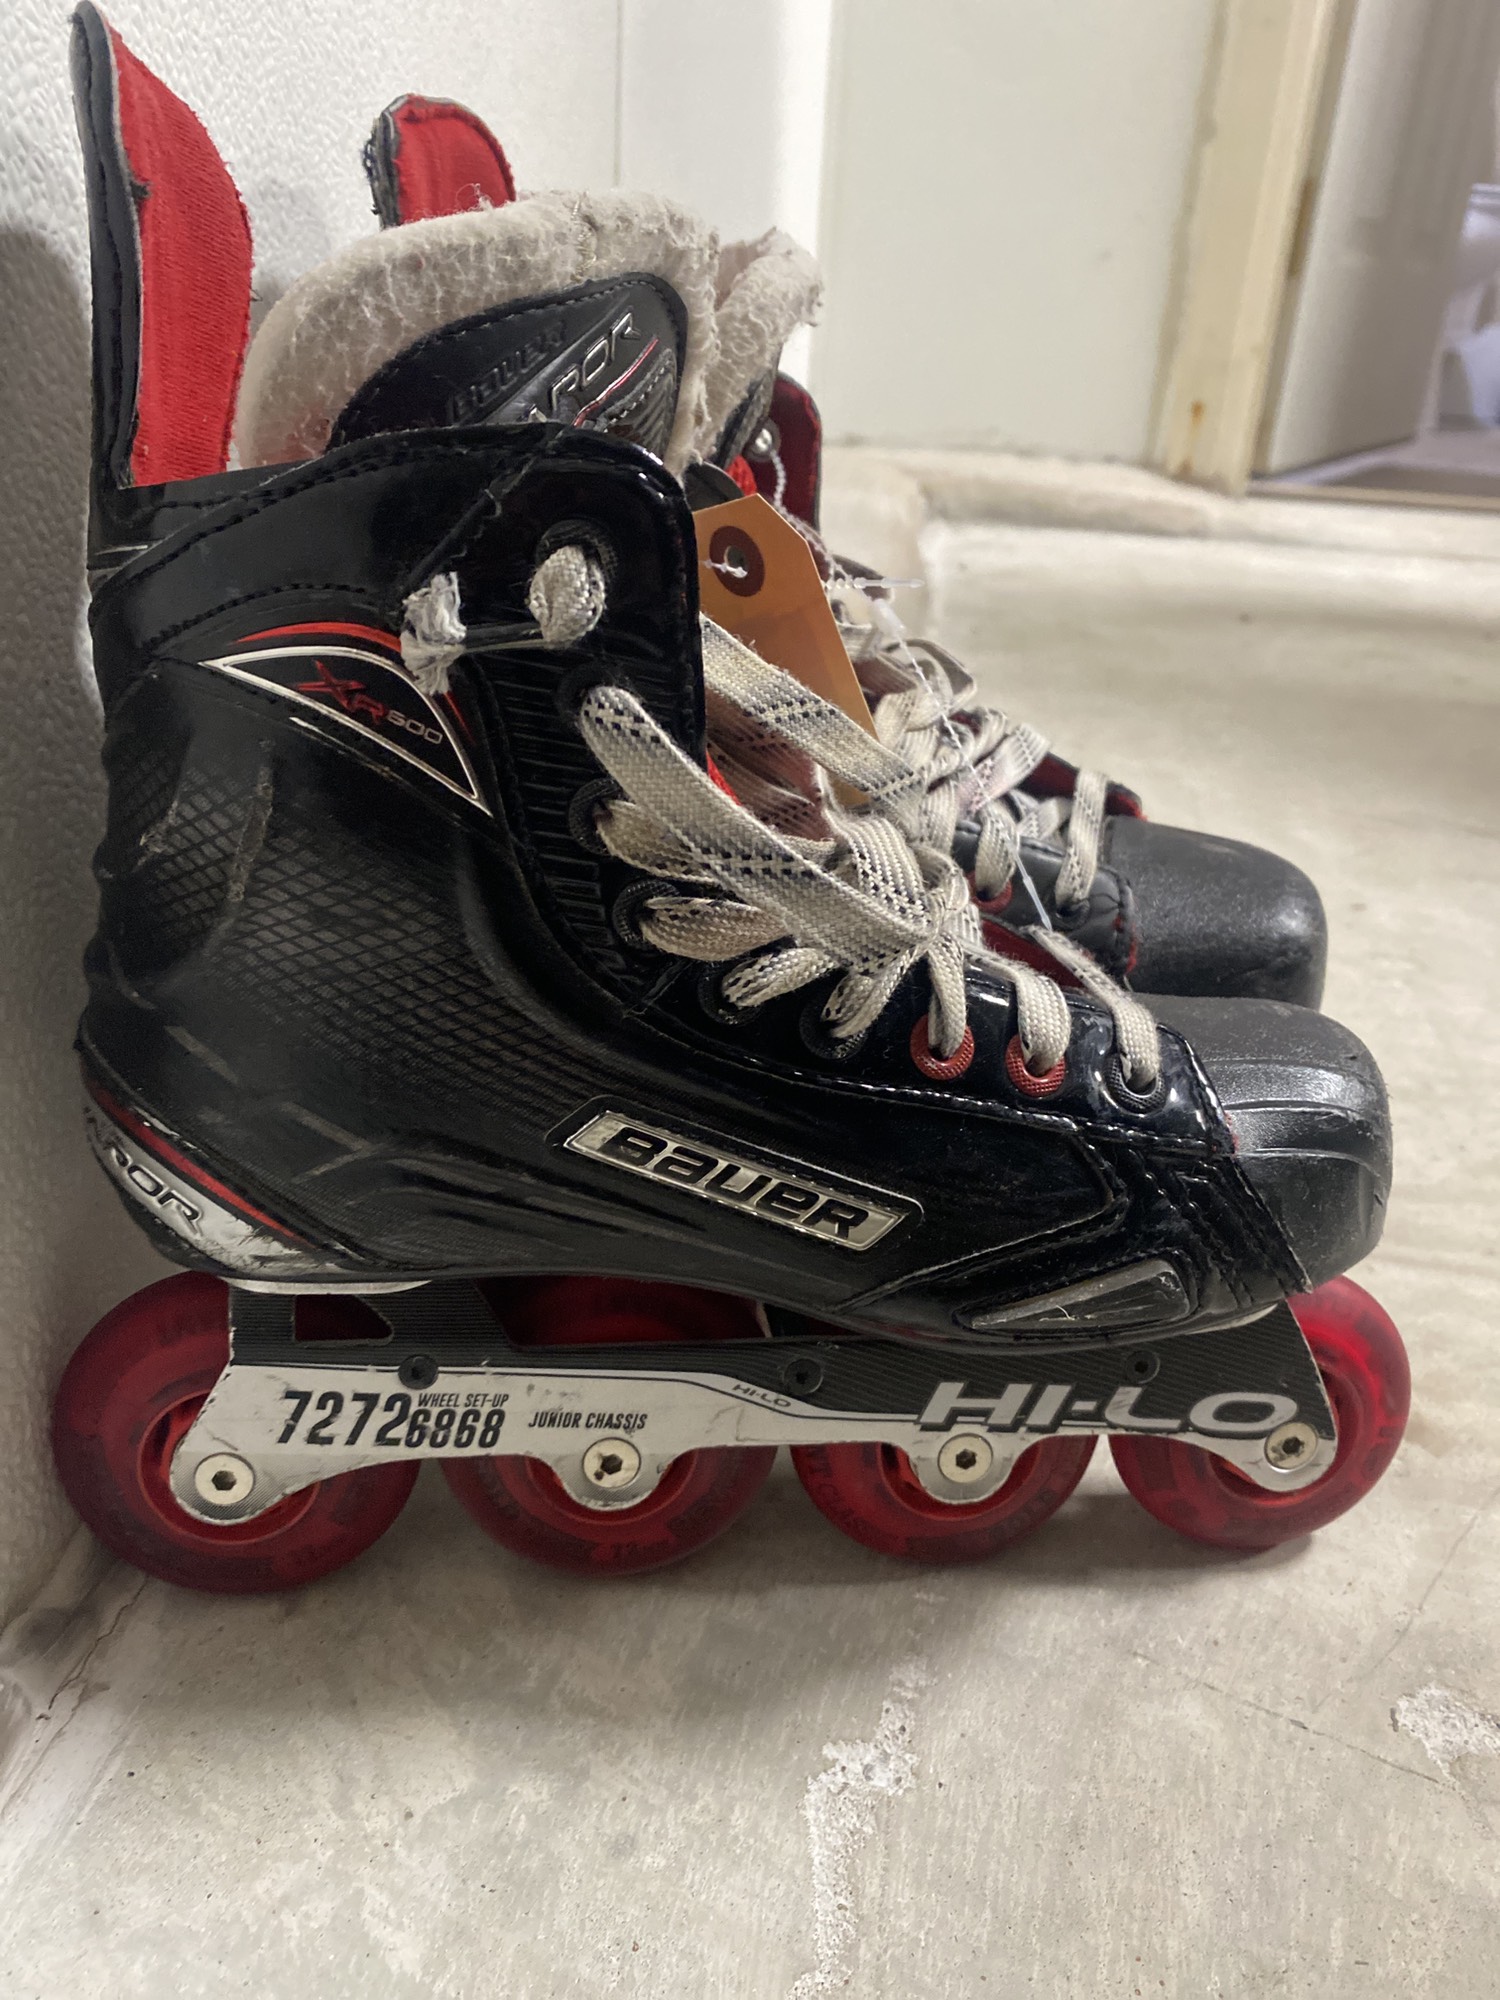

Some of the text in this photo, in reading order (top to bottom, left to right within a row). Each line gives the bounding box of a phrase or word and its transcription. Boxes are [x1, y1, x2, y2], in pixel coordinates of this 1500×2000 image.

[599, 1126, 869, 1240] BAUER
[418, 1393, 509, 1409] WHEEL SET-UP
[731, 1383, 793, 1408] HI-LO
[918, 1381, 1299, 1440] HI-LO
[277, 1390, 506, 1449] 7272 6868
[528, 1411, 648, 1430] JUNIOR CHASSIS
